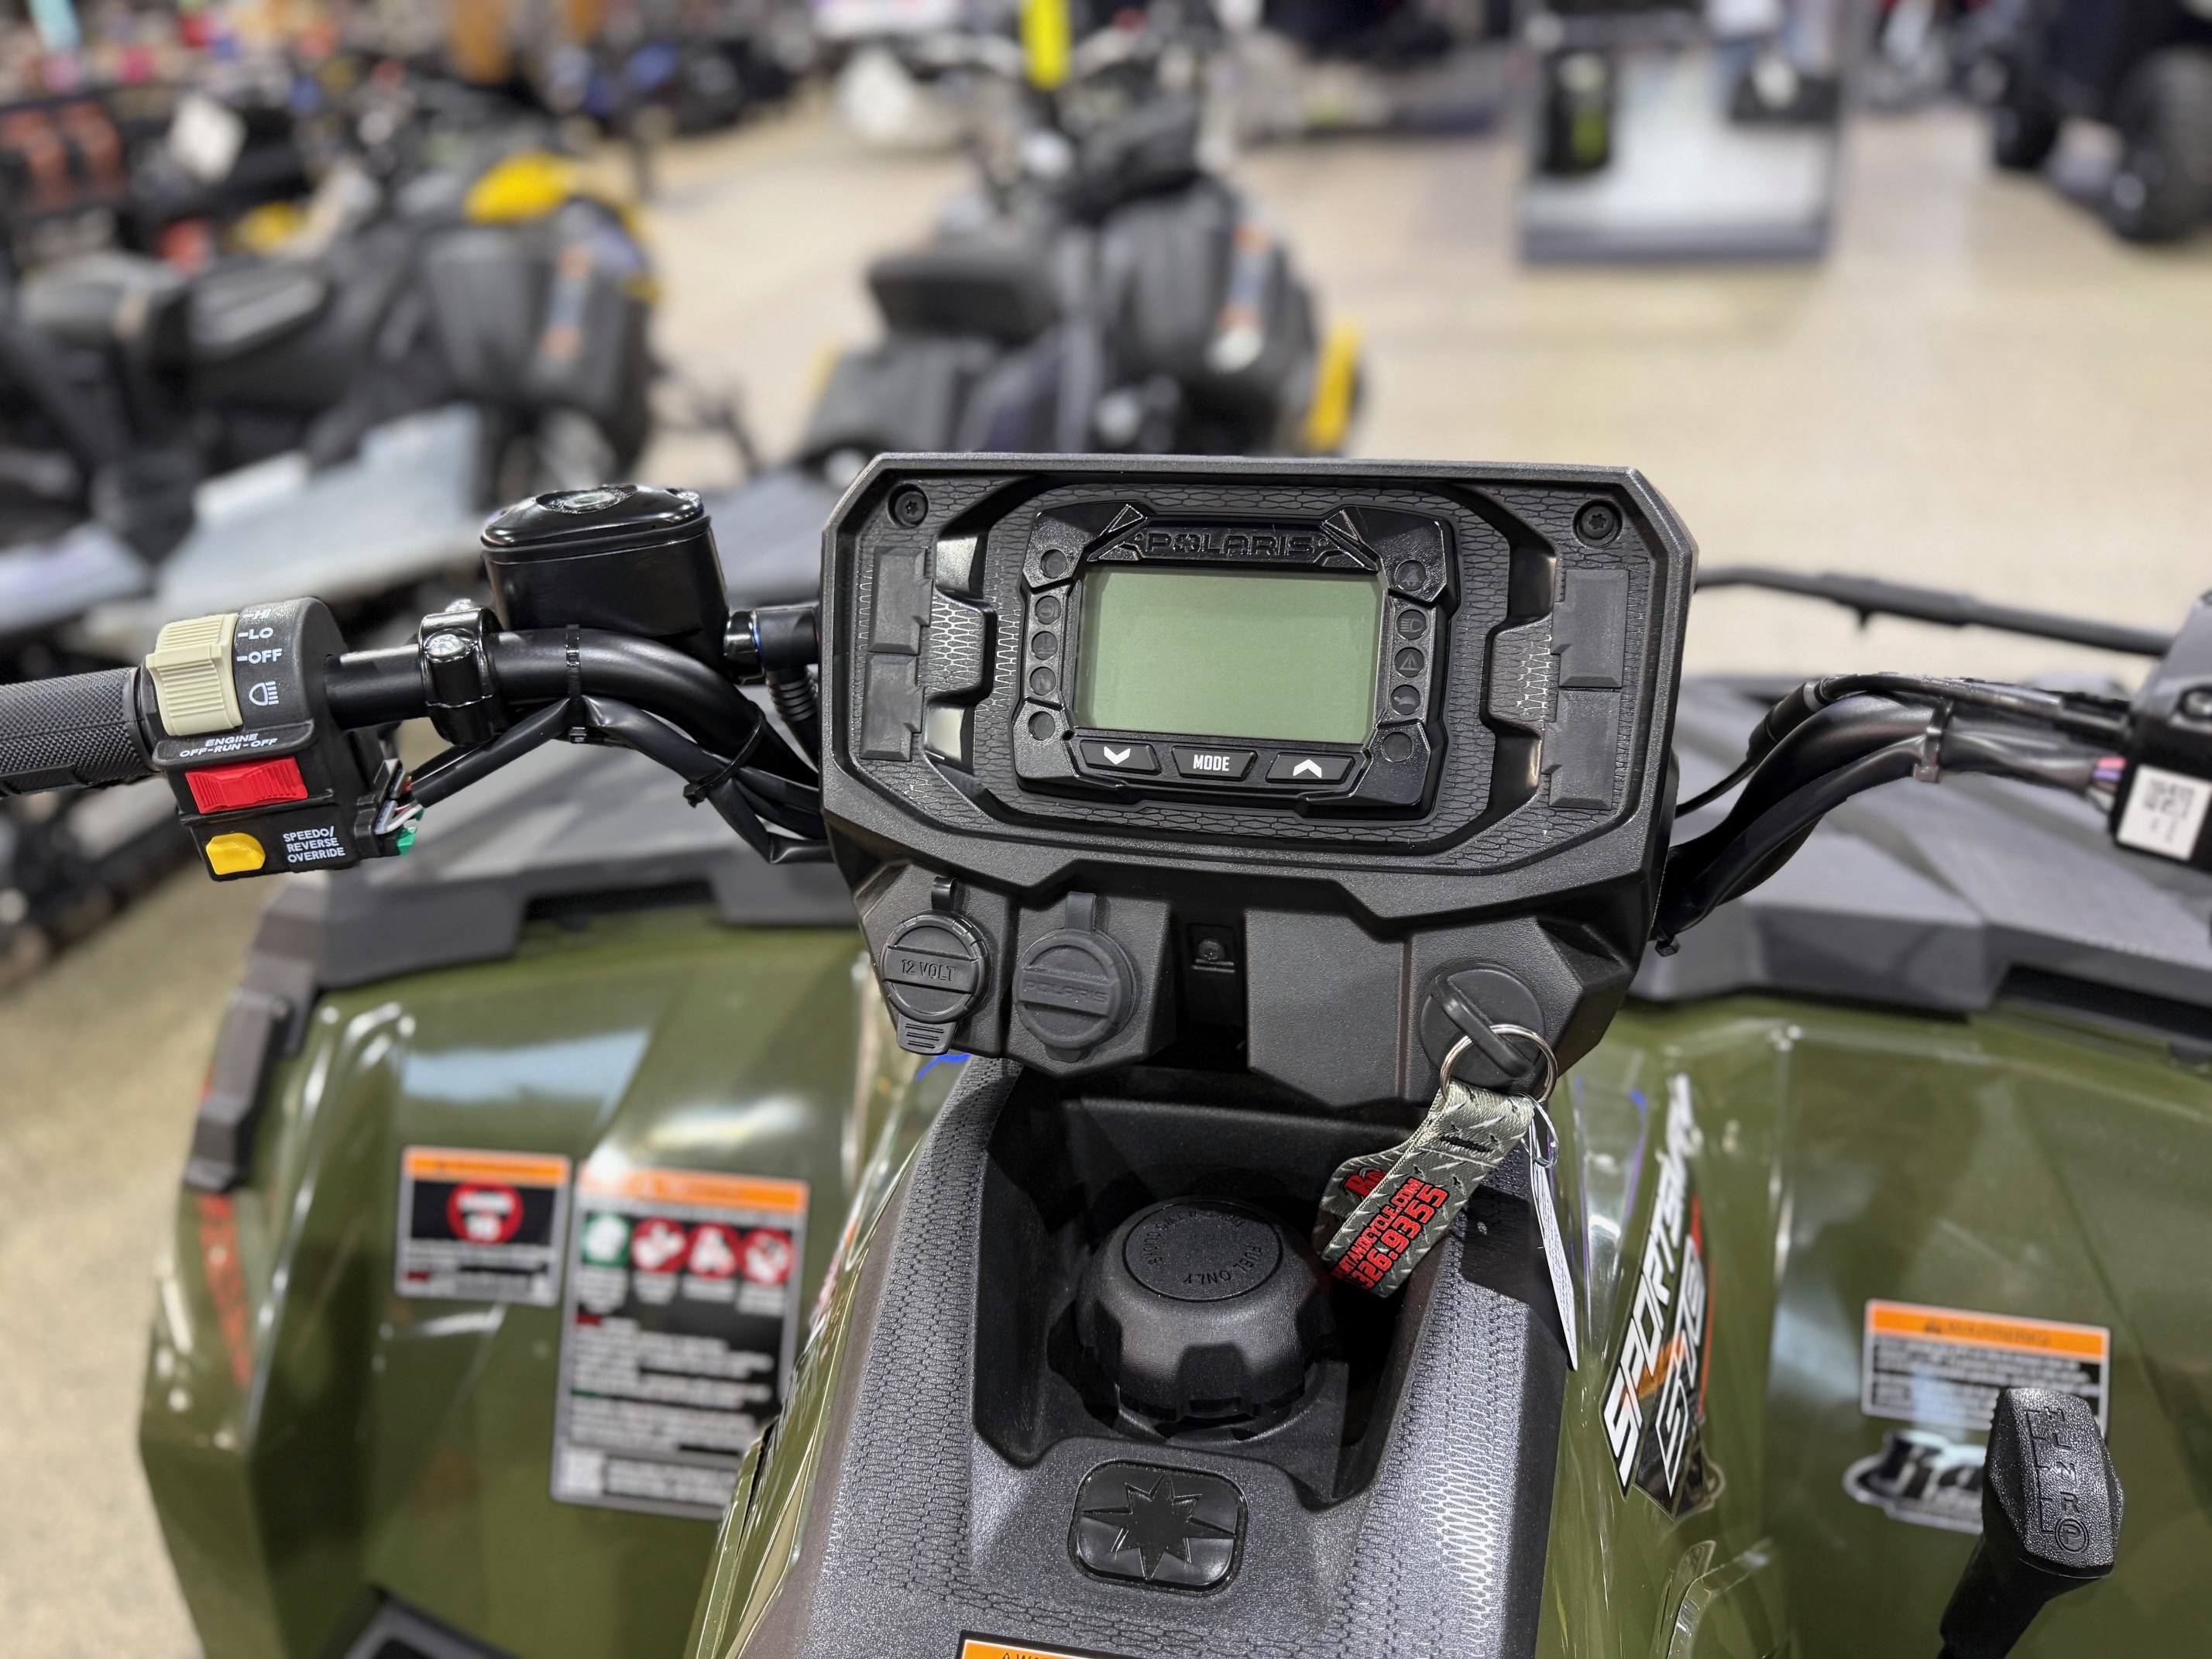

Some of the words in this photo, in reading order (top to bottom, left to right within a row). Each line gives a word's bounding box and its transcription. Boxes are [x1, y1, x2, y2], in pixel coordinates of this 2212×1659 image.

[1146, 532, 1315, 556] POLARIS
[204, 733, 259, 747] ENGINE
[1193, 754, 1230, 771] MODE
[283, 825, 335, 843] SPEEDO/
[286, 837, 339, 853] REVERSE
[287, 847, 346, 864] OVERRIDE
[902, 959, 915, 976] 12
[919, 961, 957, 982] VOLT
[1232, 1244, 1262, 1273] FUEL
[1183, 1269, 1231, 1285] ONLY
[2059, 1491, 2080, 1513] R
[2063, 1523, 2082, 1545] P
